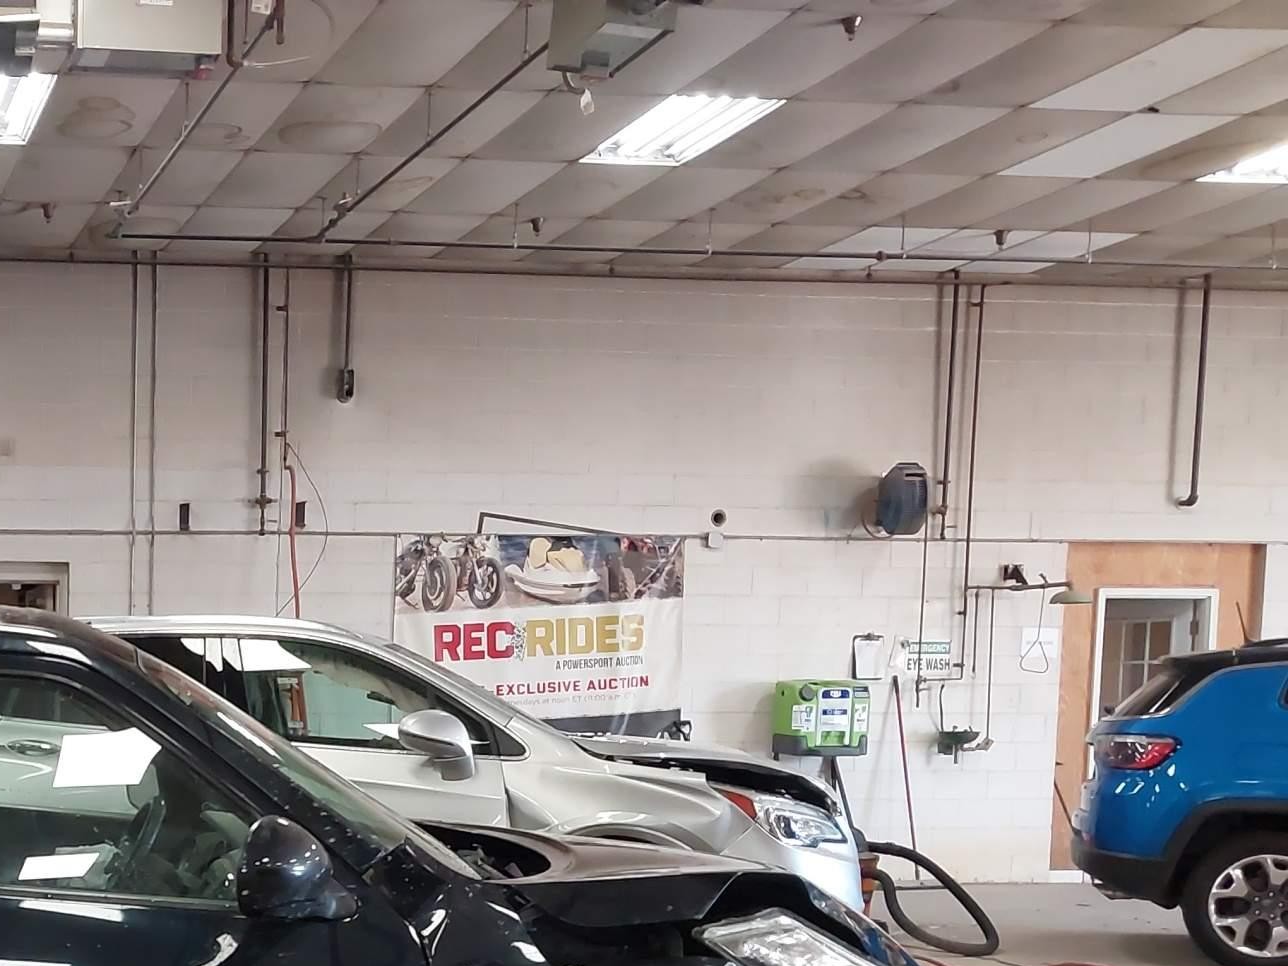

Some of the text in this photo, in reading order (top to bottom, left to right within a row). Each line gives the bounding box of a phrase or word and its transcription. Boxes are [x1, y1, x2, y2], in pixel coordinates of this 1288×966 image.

[433, 614, 645, 662] REC RIDES
[556, 655, 644, 670] A POWERSPORT AUCTION
[926, 658, 951, 671] WASH
[495, 675, 649, 696] EXCLUSIVE AUCTION
